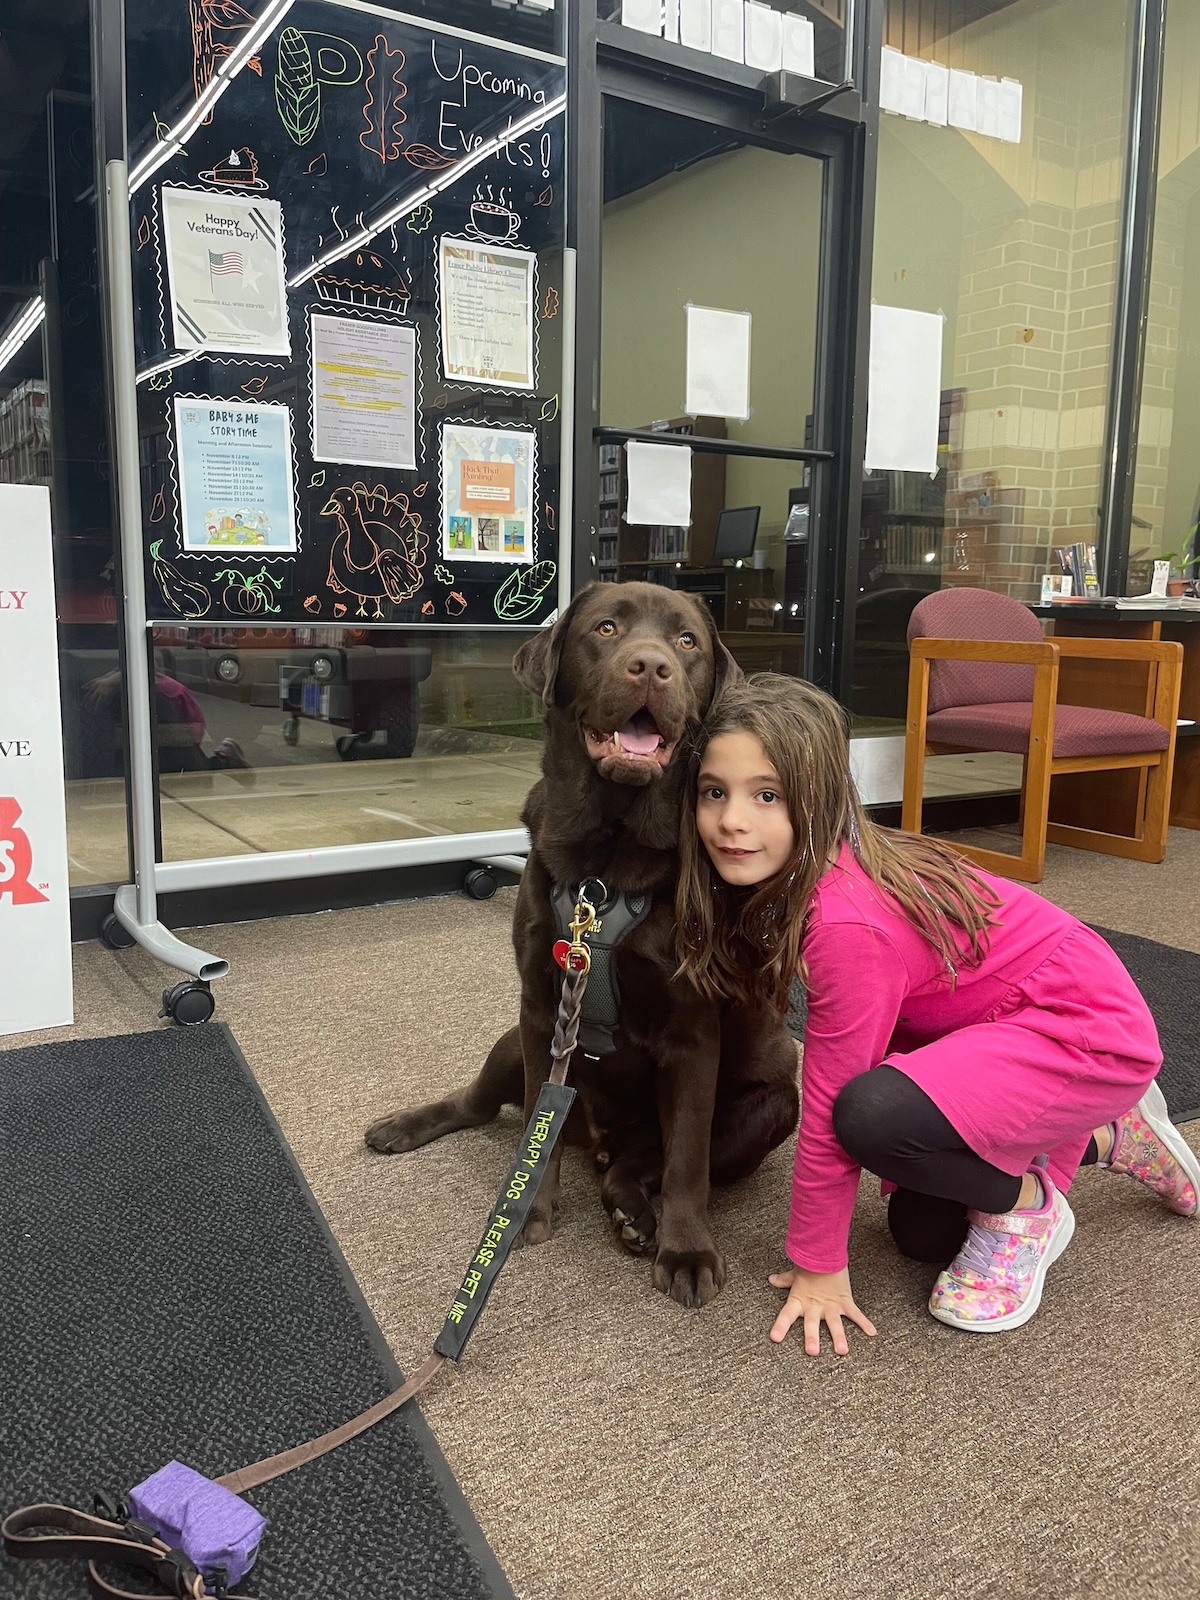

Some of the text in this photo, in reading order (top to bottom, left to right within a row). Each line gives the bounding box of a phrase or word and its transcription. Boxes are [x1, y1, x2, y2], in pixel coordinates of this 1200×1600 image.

[431, 39, 546, 131] Upcoming
[187, 221, 259, 241] Veterans Day!
[205, 213, 240, 229] Happy
[210, 410, 233, 422] BABY
[236, 413, 243, 423] &
[245, 413, 259, 424] ME
[463, 464, 499, 474] Hack That
[463, 472, 494, 482] Painting!
[38, 882, 49, 890] SM
[522, 1110, 555, 1168] THERAPY
[506, 1171, 530, 1200] DOG
[473, 1214, 511, 1267] PLEASE
[461, 1270, 483, 1299] PET
[447, 1300, 468, 1324] ME
